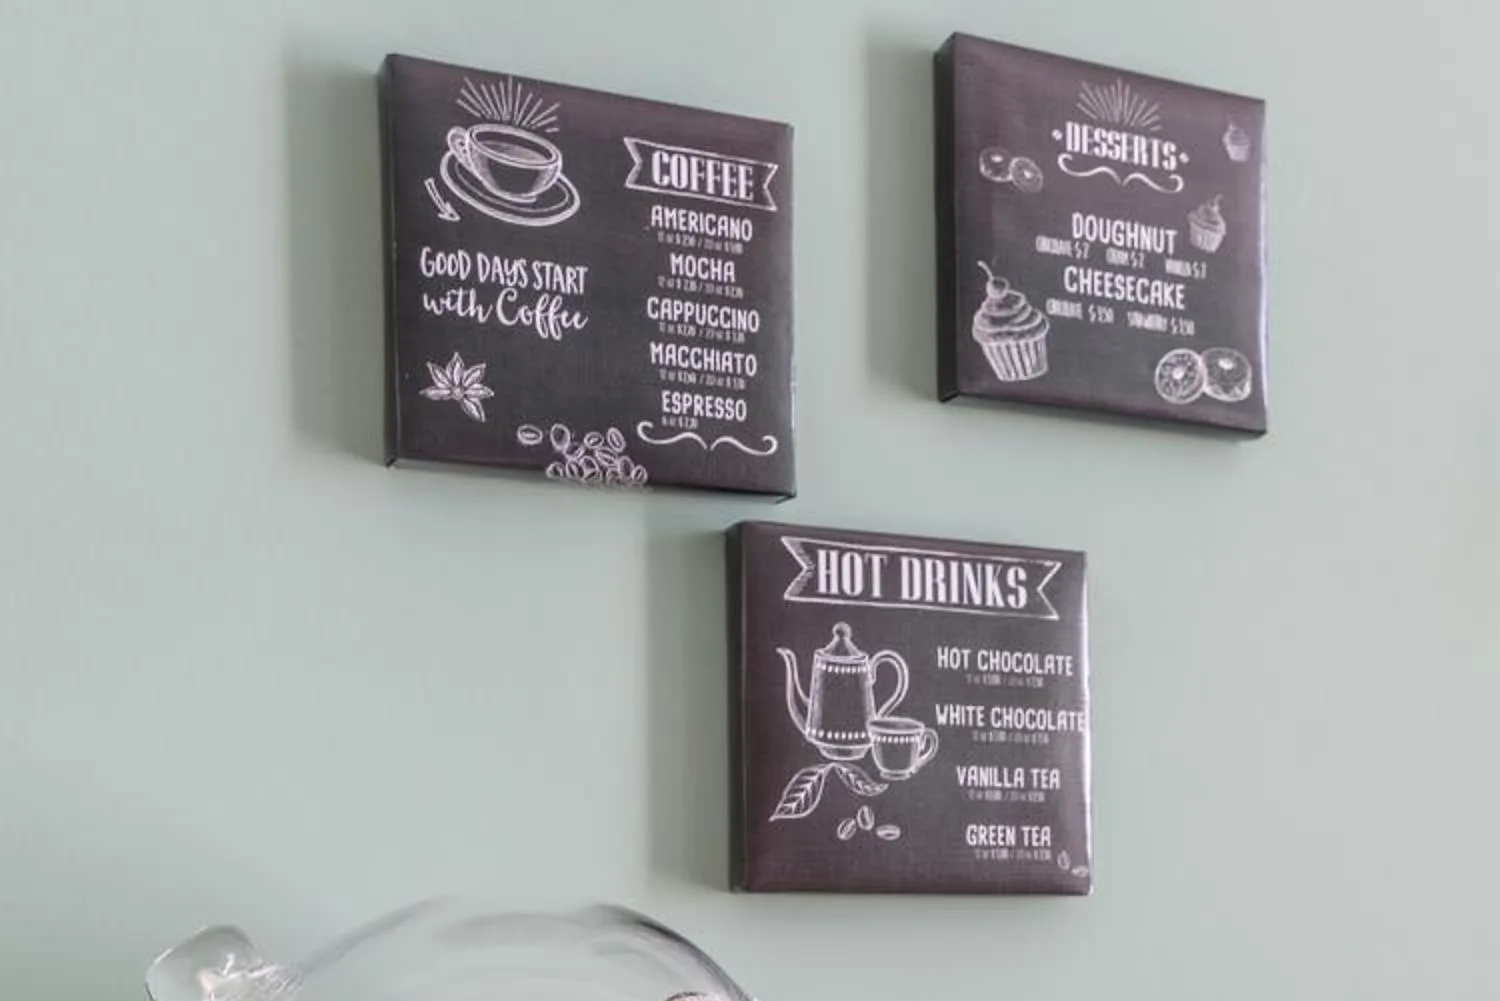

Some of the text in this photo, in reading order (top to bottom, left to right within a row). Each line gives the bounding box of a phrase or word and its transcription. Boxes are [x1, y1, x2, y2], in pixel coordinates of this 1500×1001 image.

[1066, 121, 1177, 171] DESSERTS
[651, 149, 754, 201] COFFEE
[651, 205, 753, 242] AMERICANO
[1072, 212, 1178, 255] DOUGHNUT
[420, 246, 589, 295] GOOD DAYS START
[669, 252, 736, 282] MOCHA
[1063, 266, 1186, 310] CHEESECAKE
[423, 287, 589, 340] with Coffee
[646, 296, 761, 332] CAPPUCCINO
[649, 341, 758, 377] MACCHIATO
[661, 390, 748, 422] ESPRESSO
[816, 549, 1028, 609] HOT DRINKS
[937, 647, 1074, 677] HOT CHOCOLATE
[935, 704, 1086, 733] WHITE CHOCOLATE
[956, 765, 1061, 790] VANILLA TEA
[966, 824, 1051, 848] GREEN TEA
